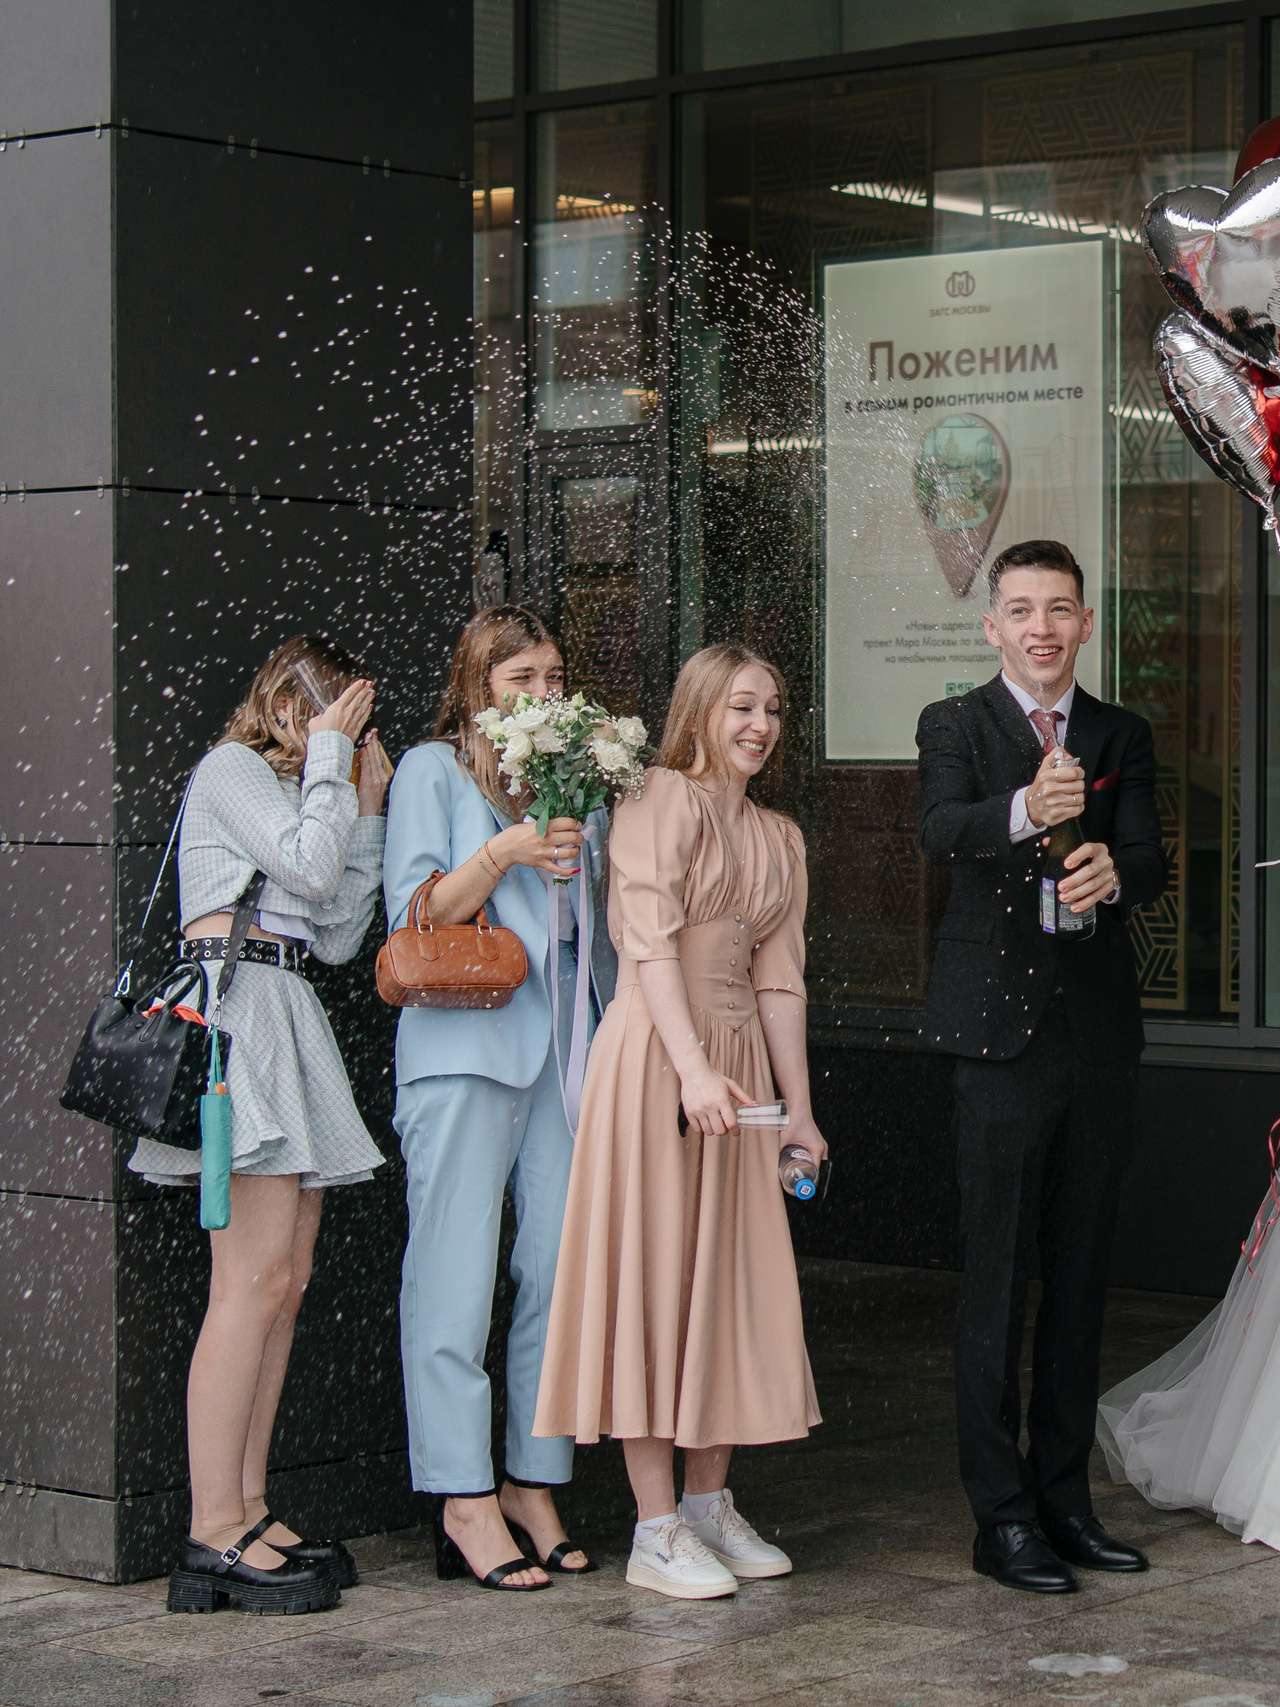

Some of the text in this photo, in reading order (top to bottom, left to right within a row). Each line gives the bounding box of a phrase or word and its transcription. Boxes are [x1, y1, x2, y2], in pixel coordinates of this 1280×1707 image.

[869, 341, 1059, 382] Поженим
[913, 389, 1029, 415] романтичном
[1034, 386, 1084, 401] месте
[922, 636, 958, 647] Москвы
